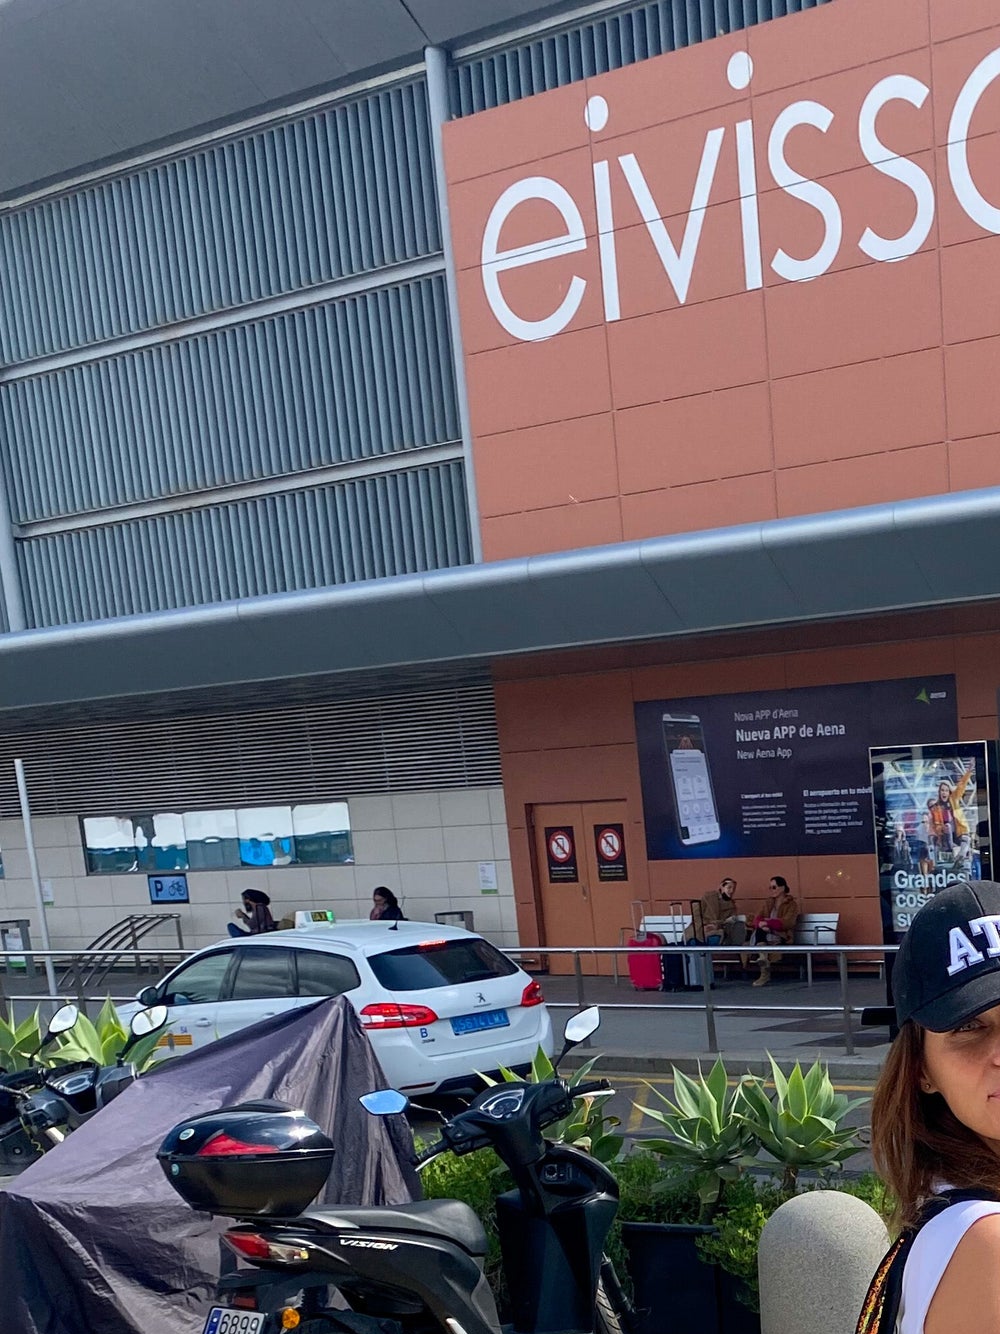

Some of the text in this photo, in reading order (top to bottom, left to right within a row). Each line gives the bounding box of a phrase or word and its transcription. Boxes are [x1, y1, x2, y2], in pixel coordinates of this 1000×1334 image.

[734, 711, 754, 722] Nova
[755, 709, 771, 720] APP
[735, 723, 846, 742] Nueva APP de Aena
[737, 747, 792, 759] New Aena App
[894, 869, 966, 889] Grandes
[154, 880, 163, 897] P
[420, 1027, 428, 1039] B
[340, 1239, 399, 1250] VISION
